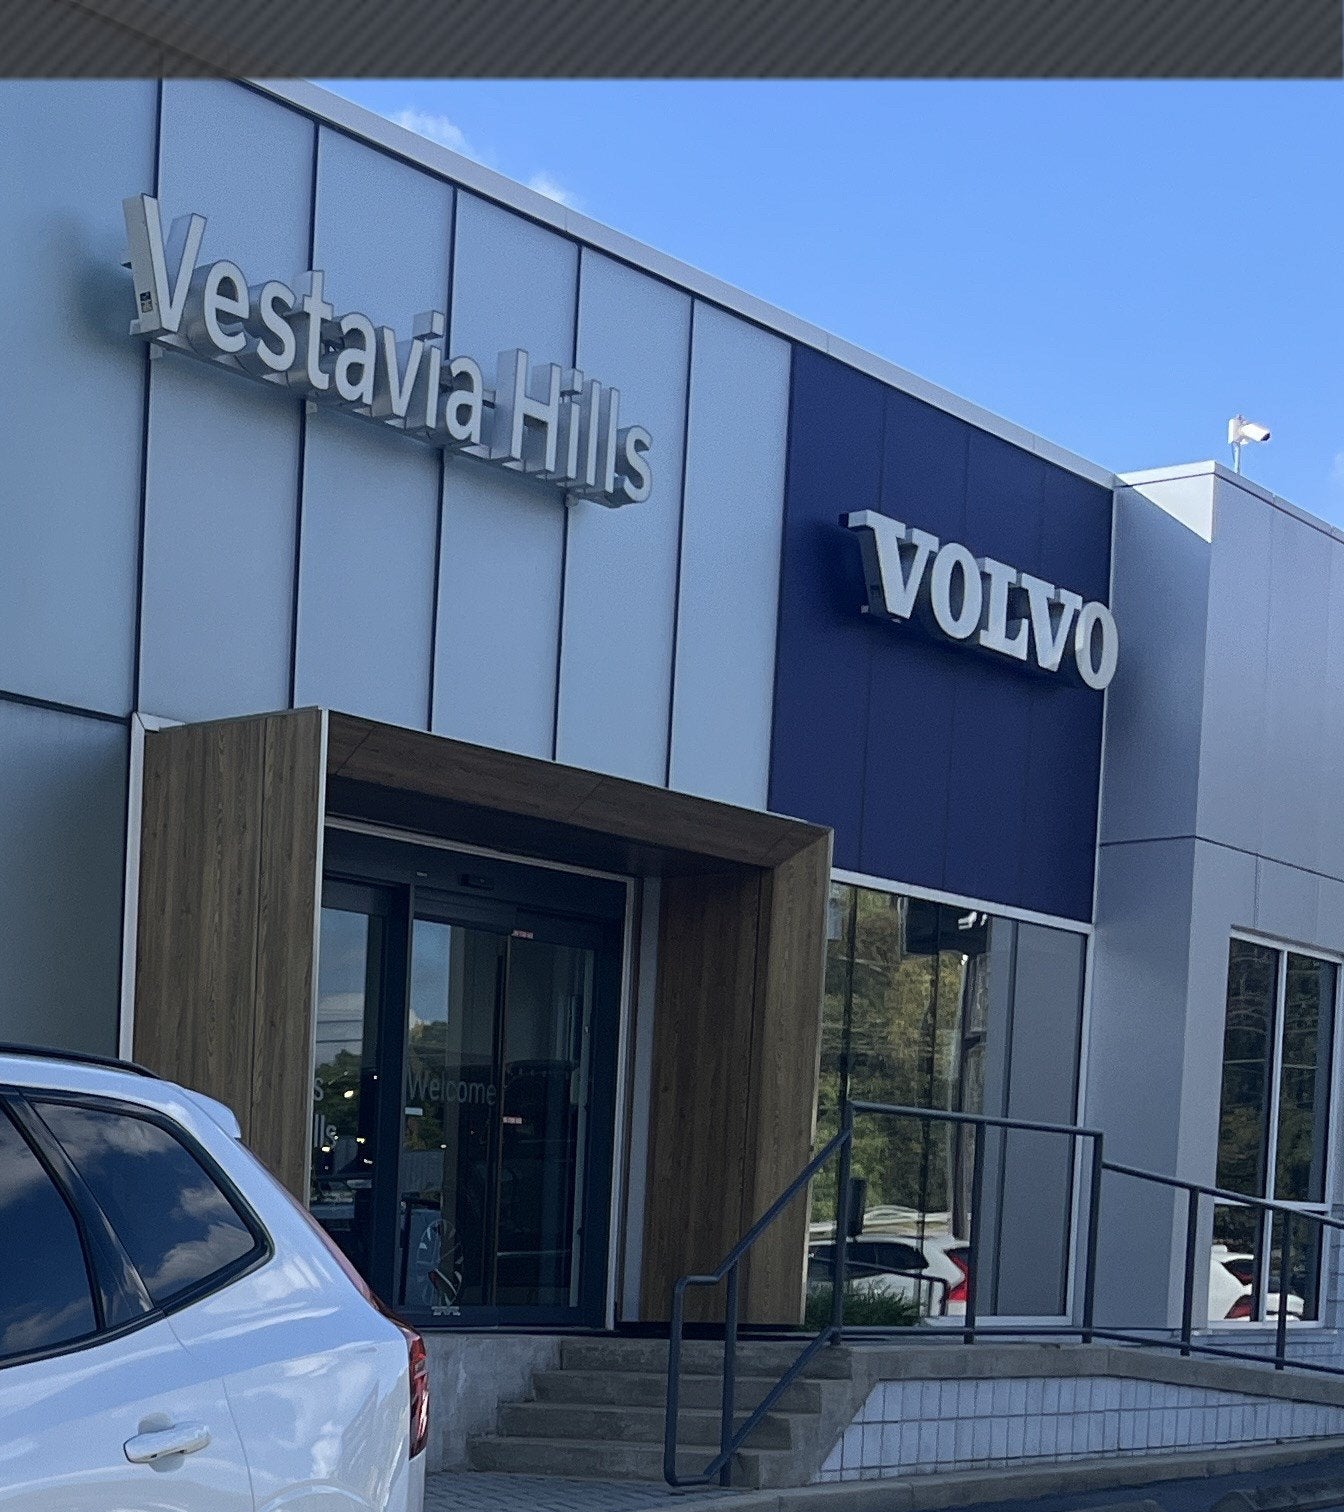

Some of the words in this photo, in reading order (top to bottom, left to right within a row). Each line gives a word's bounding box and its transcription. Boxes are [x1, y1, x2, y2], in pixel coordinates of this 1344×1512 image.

[123, 193, 486, 448] Vestavia
[503, 349, 653, 504] Hills
[845, 509, 1119, 690] VOLVO
[407, 1065, 498, 1105] Welcome
